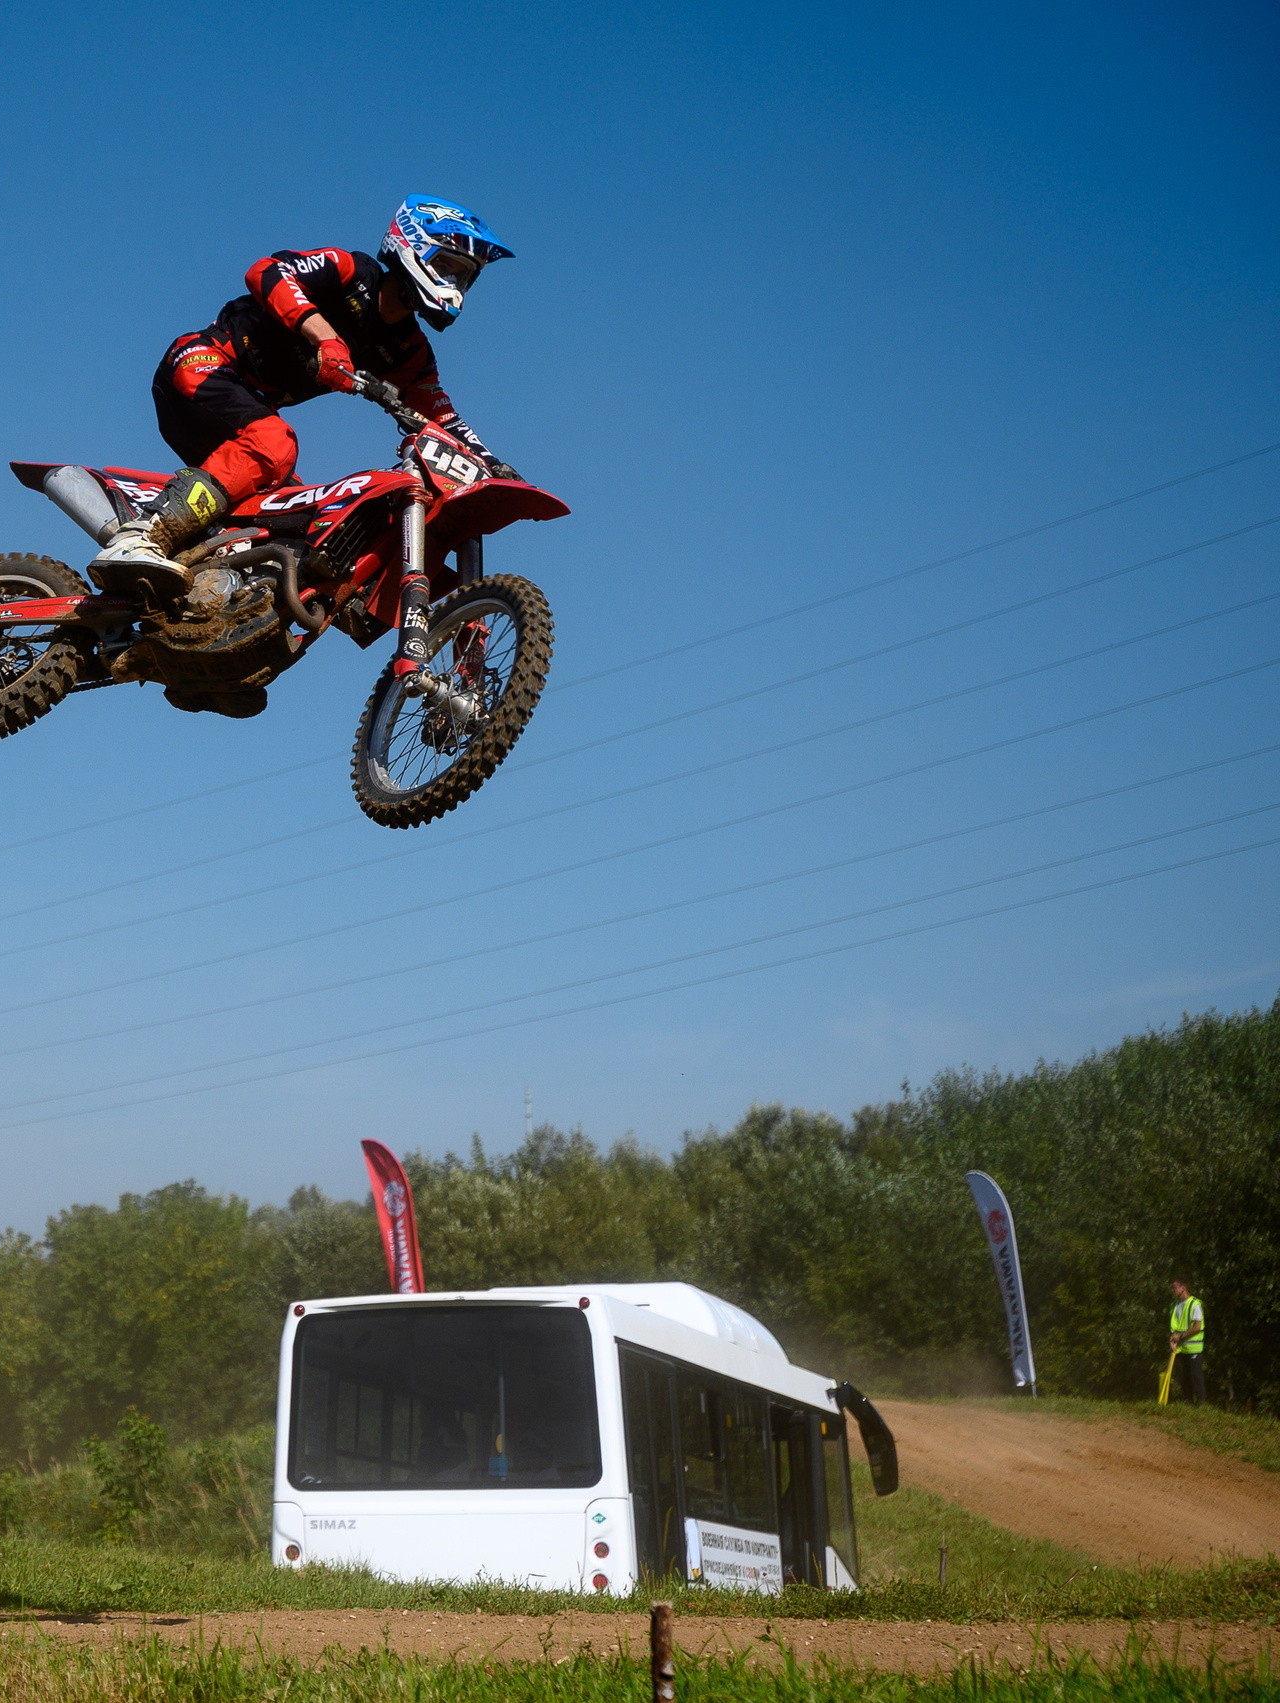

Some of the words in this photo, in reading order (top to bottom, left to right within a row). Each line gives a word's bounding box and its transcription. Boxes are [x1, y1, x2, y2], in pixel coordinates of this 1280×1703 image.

[397, 209, 427, 251] 100%
[295, 250, 339, 273] LAVR
[421, 440, 479, 484] 49
[260, 475, 372, 510] LAVR
[405, 614, 426, 624] MO
[310, 1519, 356, 1530] SIMAZ
